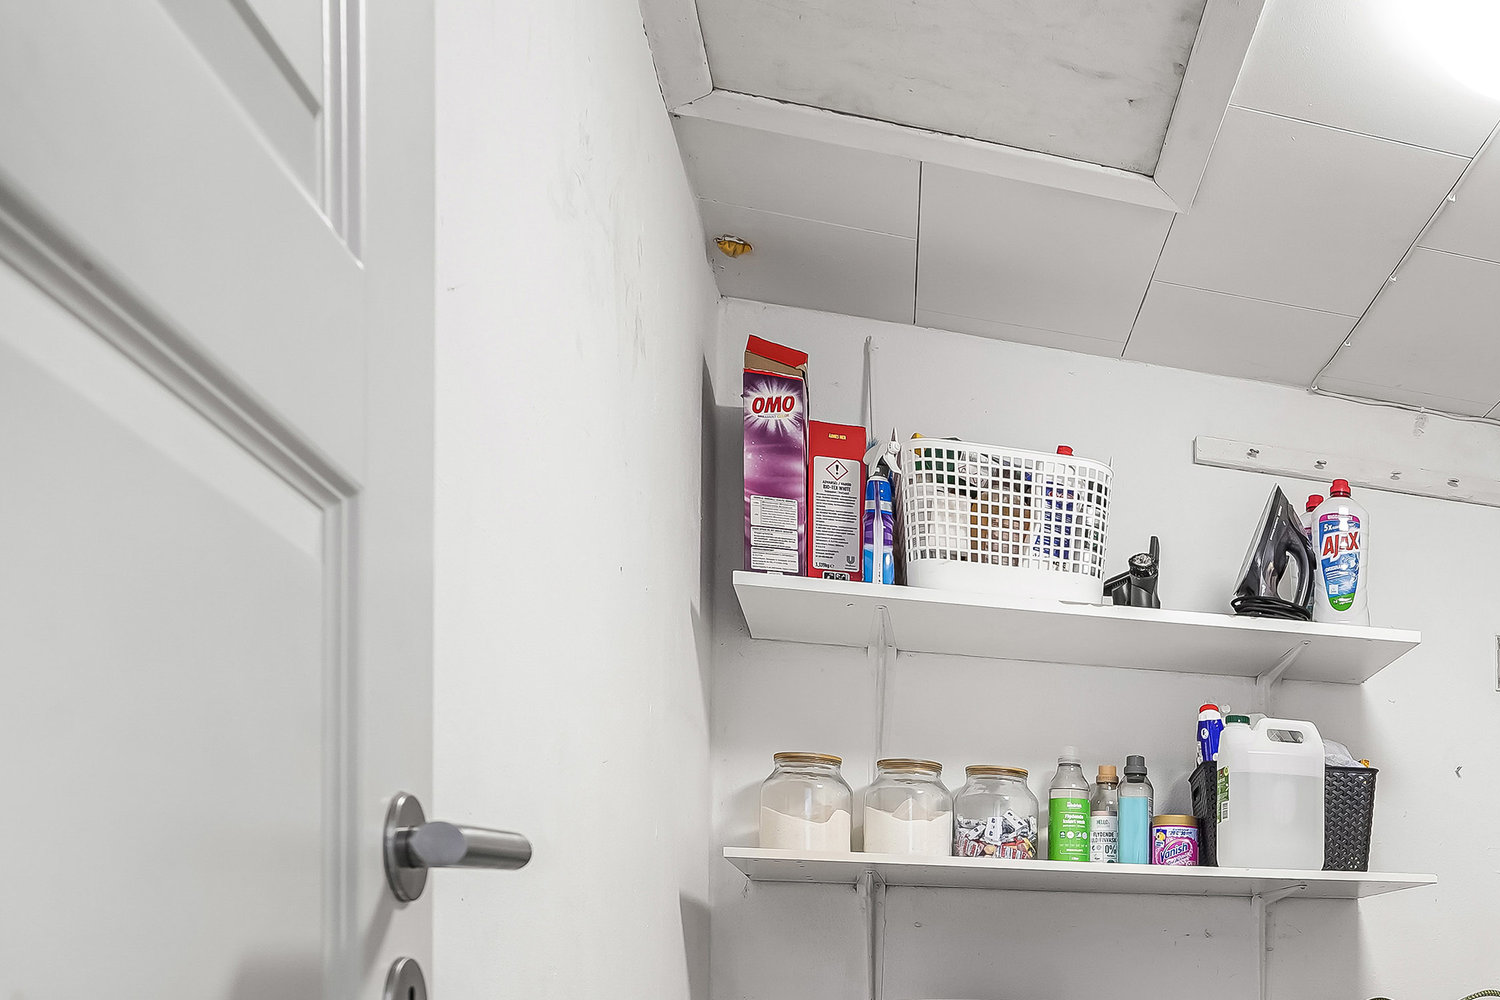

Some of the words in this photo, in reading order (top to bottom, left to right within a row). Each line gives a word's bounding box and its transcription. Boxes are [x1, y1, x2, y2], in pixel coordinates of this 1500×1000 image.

[752, 395, 795, 414] OMO
[1323, 531, 1359, 559] AJAX
[1105, 844, 1117, 854] 0%
[1160, 842, 1188, 863] Vanish
